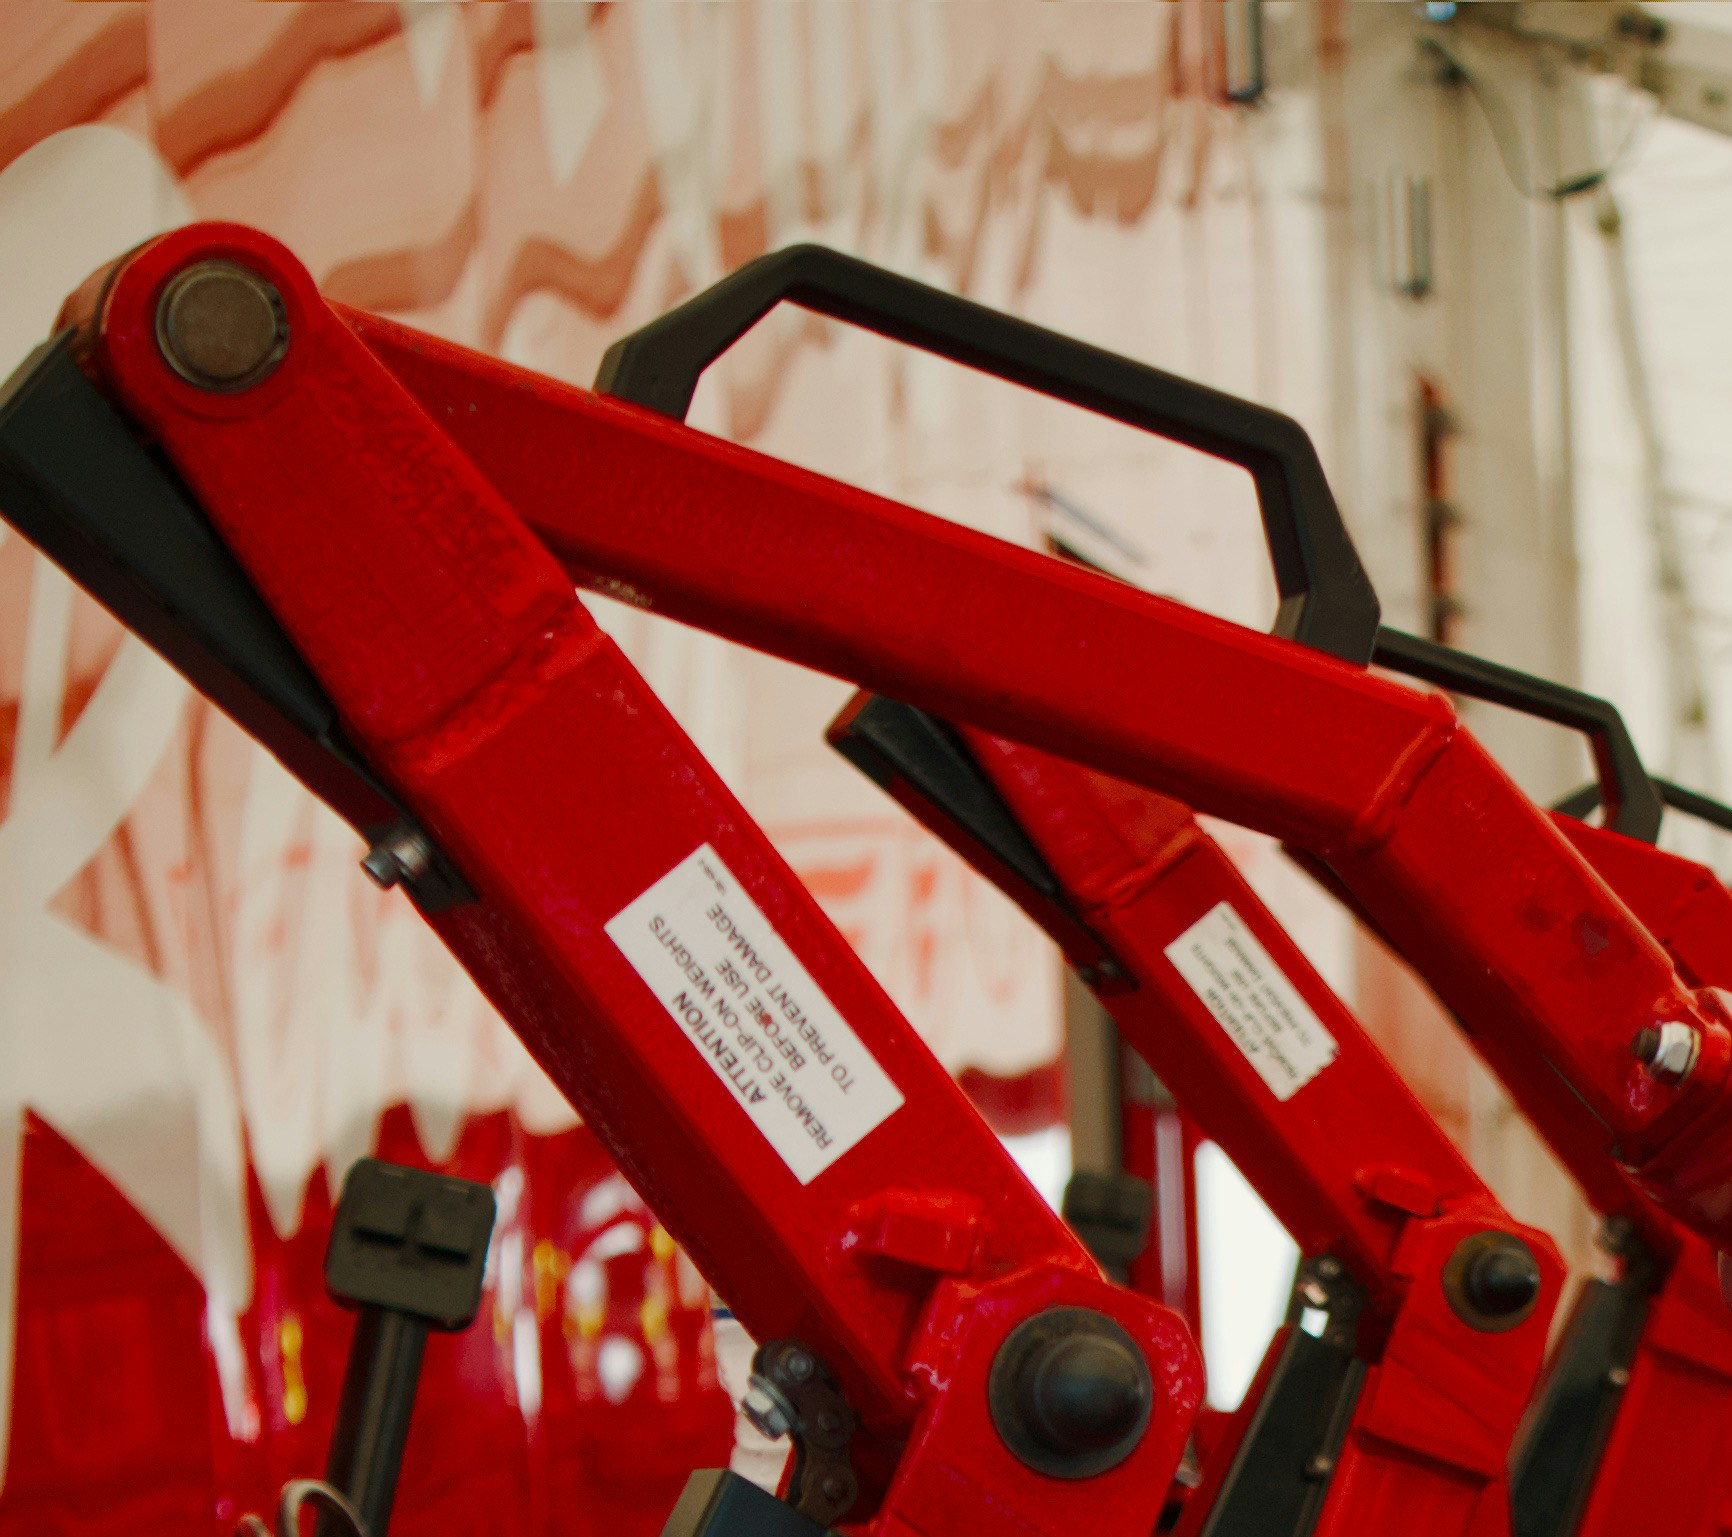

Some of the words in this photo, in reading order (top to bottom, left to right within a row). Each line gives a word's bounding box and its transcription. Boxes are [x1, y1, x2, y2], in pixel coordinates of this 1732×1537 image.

[646, 914, 717, 1000] WEIGHTS
[705, 902, 773, 984] DAMAGE
[713, 958, 750, 1000] USE
[670, 989, 768, 1105] ATTENTION
[711, 997, 774, 1074] CLIP-ON
[744, 996, 807, 1072] BEFORE
[765, 981, 836, 1066] PREVENT
[767, 1071, 833, 1150] REMOVE
[829, 1062, 855, 1093] TO
